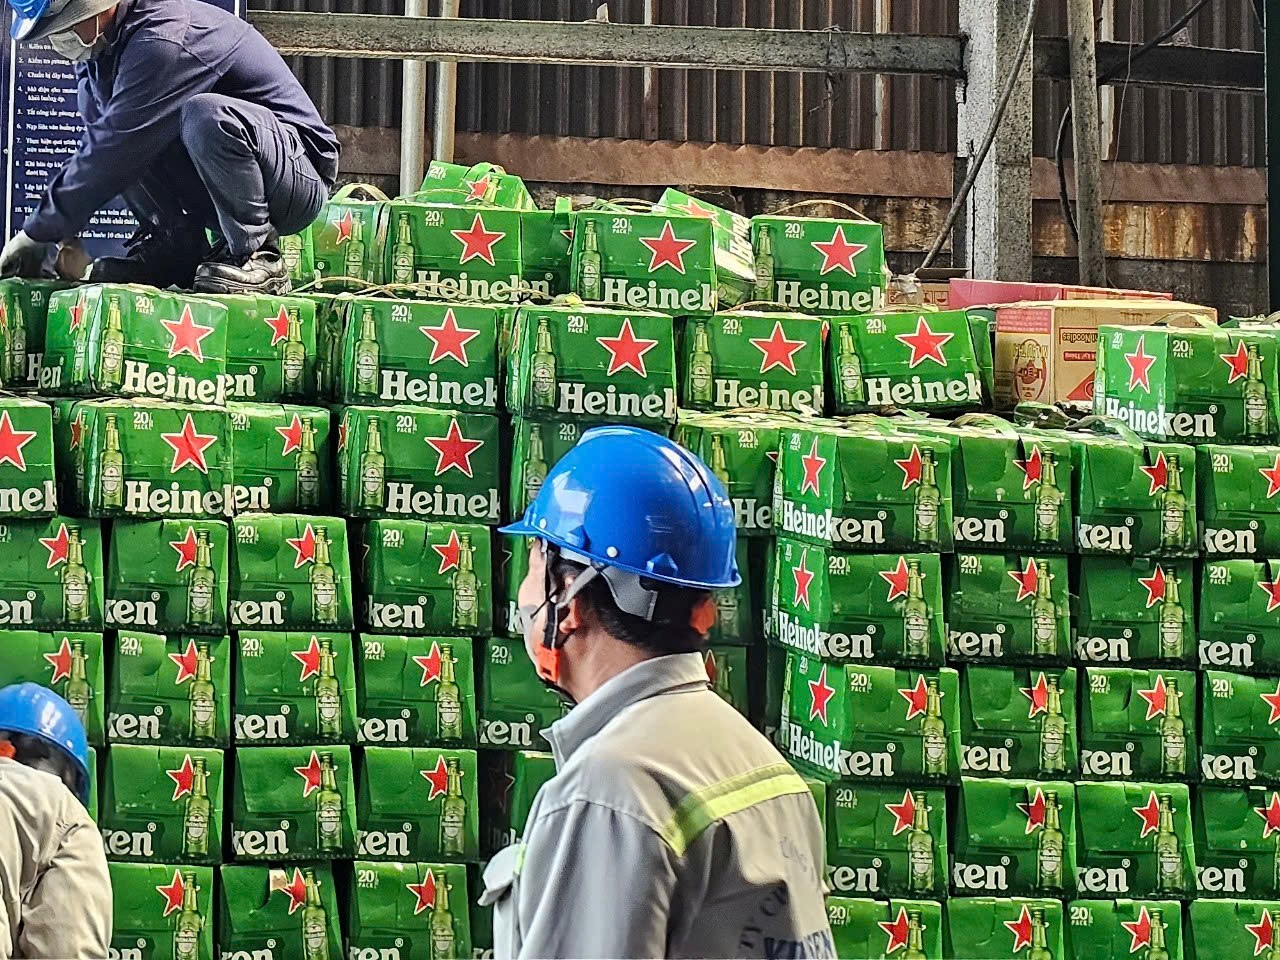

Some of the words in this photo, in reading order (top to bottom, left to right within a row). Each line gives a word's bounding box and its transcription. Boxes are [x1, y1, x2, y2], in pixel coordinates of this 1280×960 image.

[425, 211, 440, 221] 20
[612, 218, 628, 229] 20
[785, 223, 800, 232] 20
[136, 296, 150, 306] 20
[391, 305, 408, 317] 20
[567, 316, 584, 327] 20
[723, 319, 739, 329] 20
[866, 318, 882, 329] 20
[1173, 340, 1188, 351] 20
[134, 412, 149, 423] 20
[231, 413, 246, 424] 20
[396, 415, 413, 427] 20
[559, 423, 575, 433] 20
[738, 431, 755, 442] 20
[1213, 454, 1228, 465] 20
[238, 526, 254, 537] 20
[383, 530, 400, 541] 20
[828, 556, 845, 568] 20
[961, 555, 977, 567] 20
[1210, 566, 1226, 578] 20
[121, 637, 138, 649] 20
[242, 638, 259, 650] 20
[364, 642, 381, 653] 20
[492, 646, 508, 656] 20
[851, 673, 867, 686] 20
[1091, 675, 1107, 686] 20
[1212, 679, 1229, 691] 20
[836, 789, 852, 801] 20
[357, 870, 374, 882] 20
[829, 906, 846, 918] 20
[1070, 907, 1088, 920] 20
